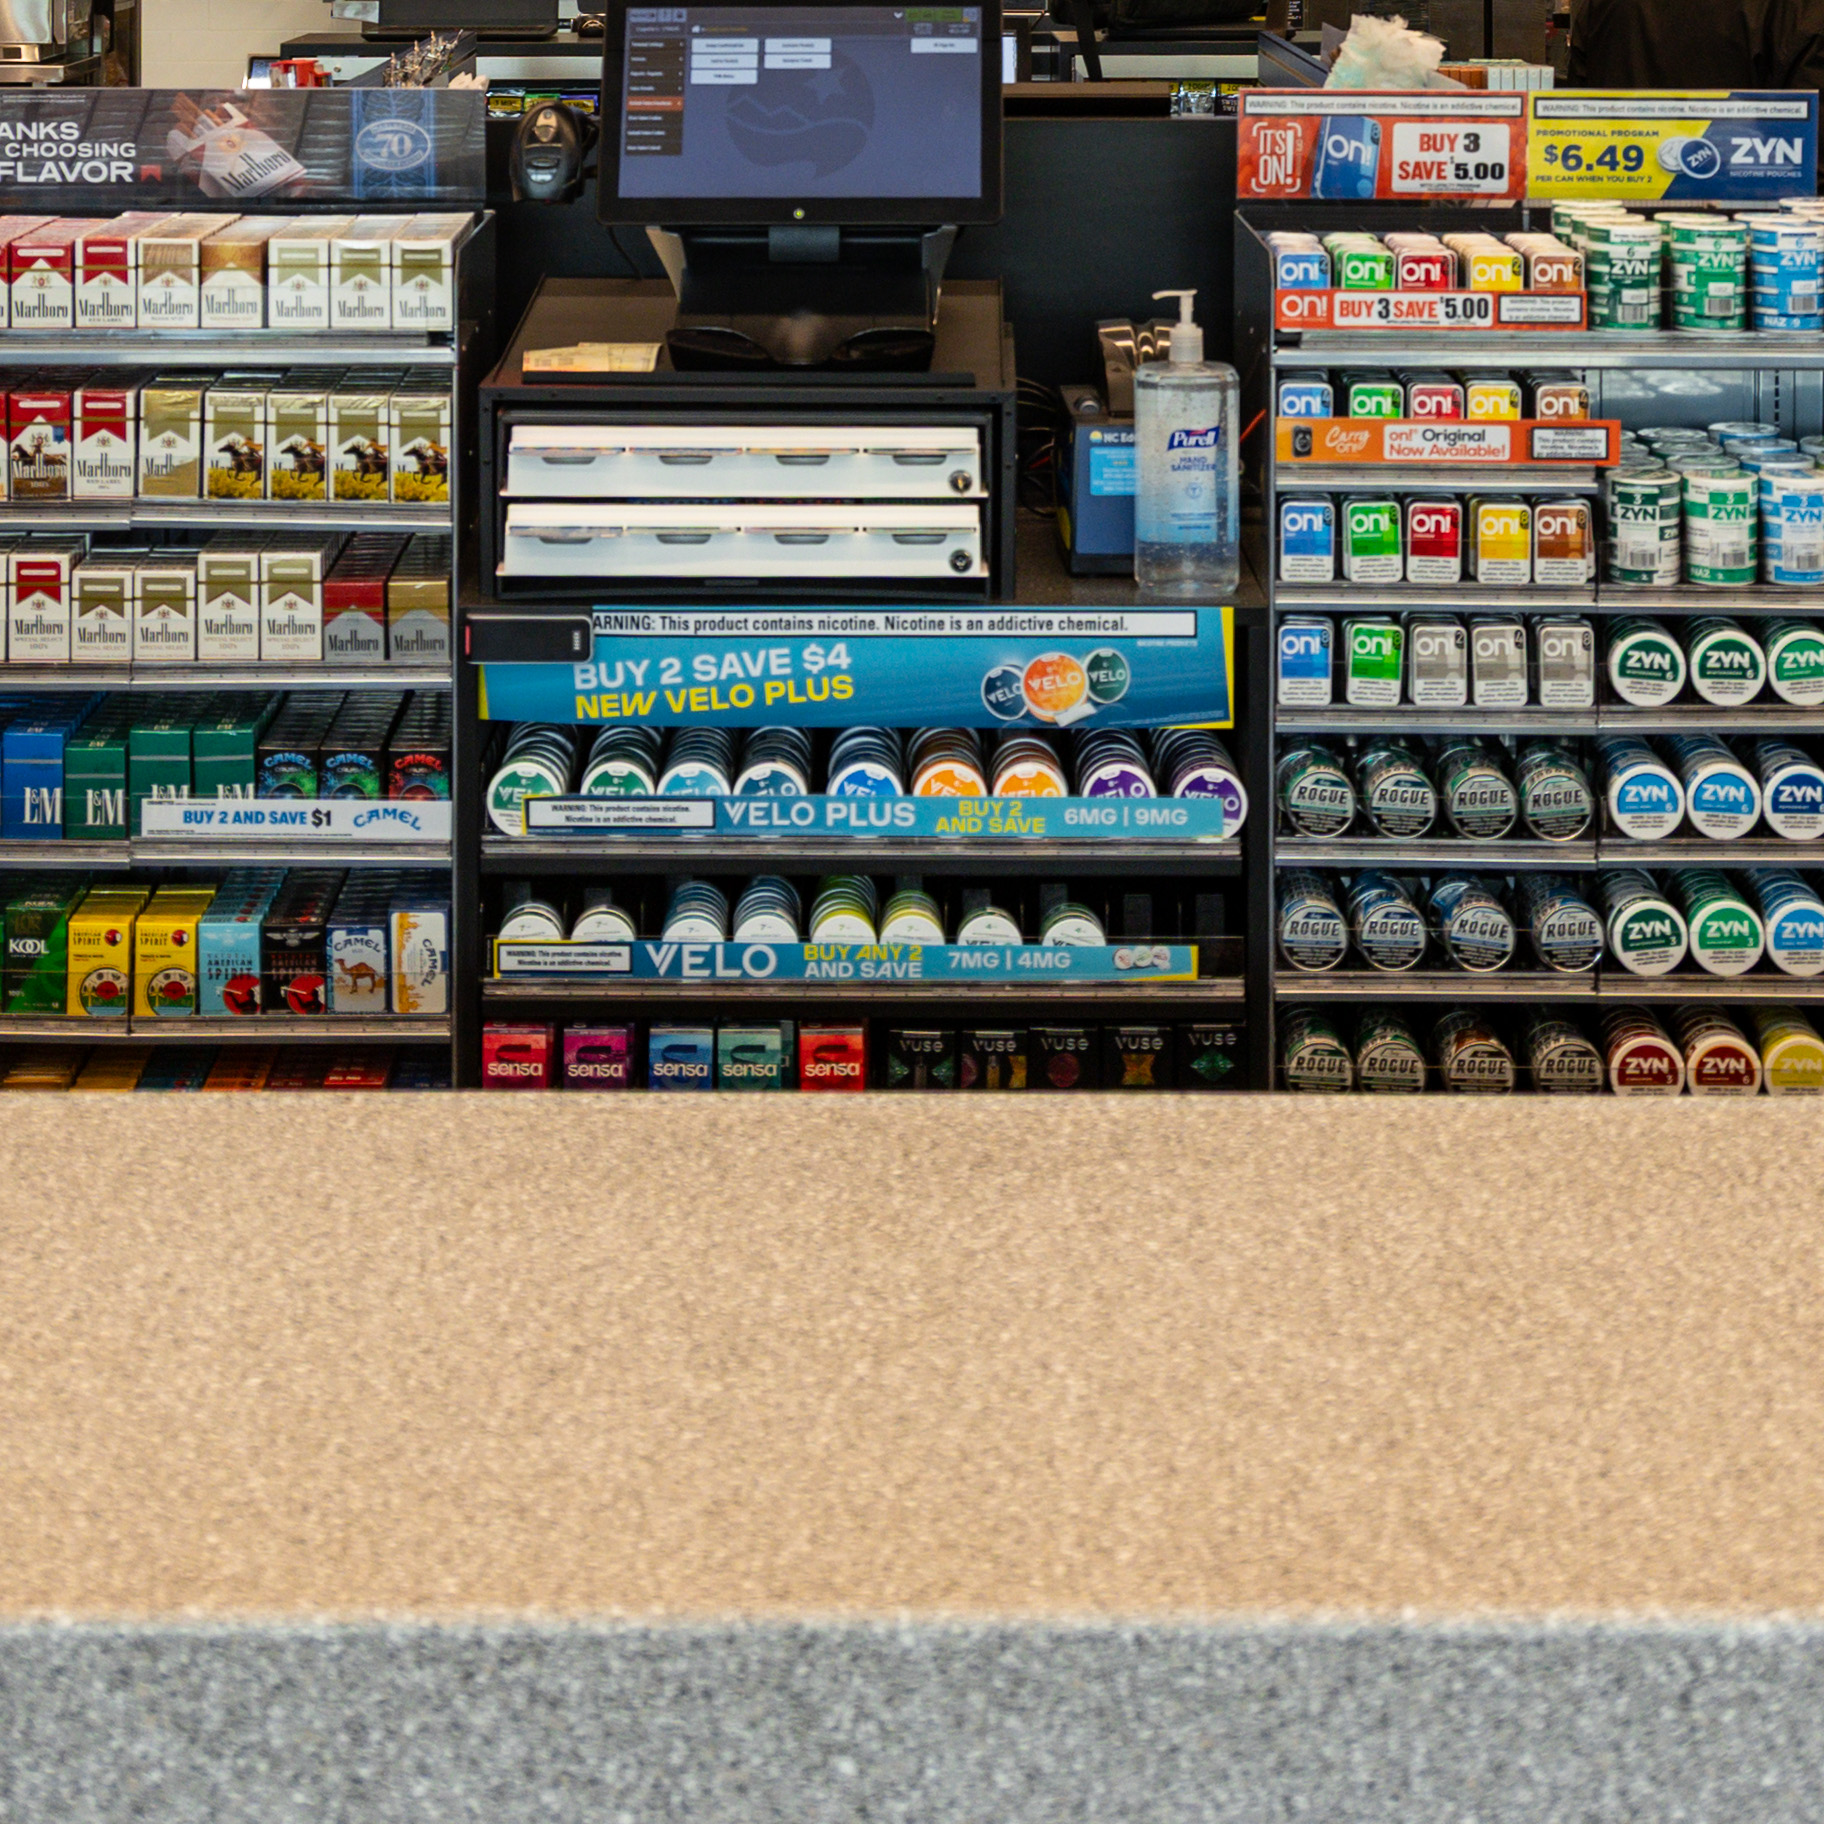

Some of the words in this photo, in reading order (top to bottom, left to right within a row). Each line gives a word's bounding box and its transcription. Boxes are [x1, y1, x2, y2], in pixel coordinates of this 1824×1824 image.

[6, 143, 136, 158] CHOOSING
[1420, 134, 1459, 152] BUY
[1463, 133, 1480, 152] 3
[1731, 137, 1803, 164] ZYN
[1544, 144, 1644, 172] $6.49
[221, 149, 291, 192] Marlboro
[1398, 162, 1448, 180] SAVE
[1450, 156, 1504, 180] $5.00
[1422, 429, 1485, 445] Original
[1389, 445, 1425, 457] Now
[1429, 444, 1506, 458] Available!
[589, 615, 655, 631] ARNING:
[660, 616, 689, 631] This
[694, 616, 746, 634] product
[751, 616, 813, 631] contains
[818, 616, 879, 631] nicotine.
[885, 617, 946, 631] Nicotine
[950, 617, 961, 631] is
[966, 620, 982, 631] an
[987, 617, 1053, 631] addictive
[1058, 617, 1128, 631] chemical.
[574, 659, 650, 689] BUY
[659, 658, 682, 684] 2
[693, 648, 791, 681] SAVE
[802, 643, 852, 674] $4
[1704, 649, 1750, 668] ZYN
[576, 691, 657, 719] NEW
[665, 684, 755, 713] VELO
[764, 675, 853, 705] PLUS
[1298, 786, 1347, 805] ROGUE
[183, 811, 214, 824] BUY
[219, 811, 228, 824] 2
[232, 811, 265, 825] AND
[269, 811, 307, 825] SAVE
[311, 808, 332, 828] $1
[724, 801, 815, 826] VELO
[826, 803, 916, 826] PLUS
[959, 801, 1005, 816] BUY
[1009, 801, 1021, 816] 2
[1064, 808, 1116, 825] 6MG
[1135, 808, 1188, 825] 9MG
[353, 808, 421, 831] CAMEL
[936, 817, 982, 833] AND
[988, 817, 1046, 833] SAVE
[487, 1062, 543, 1078] sensa
